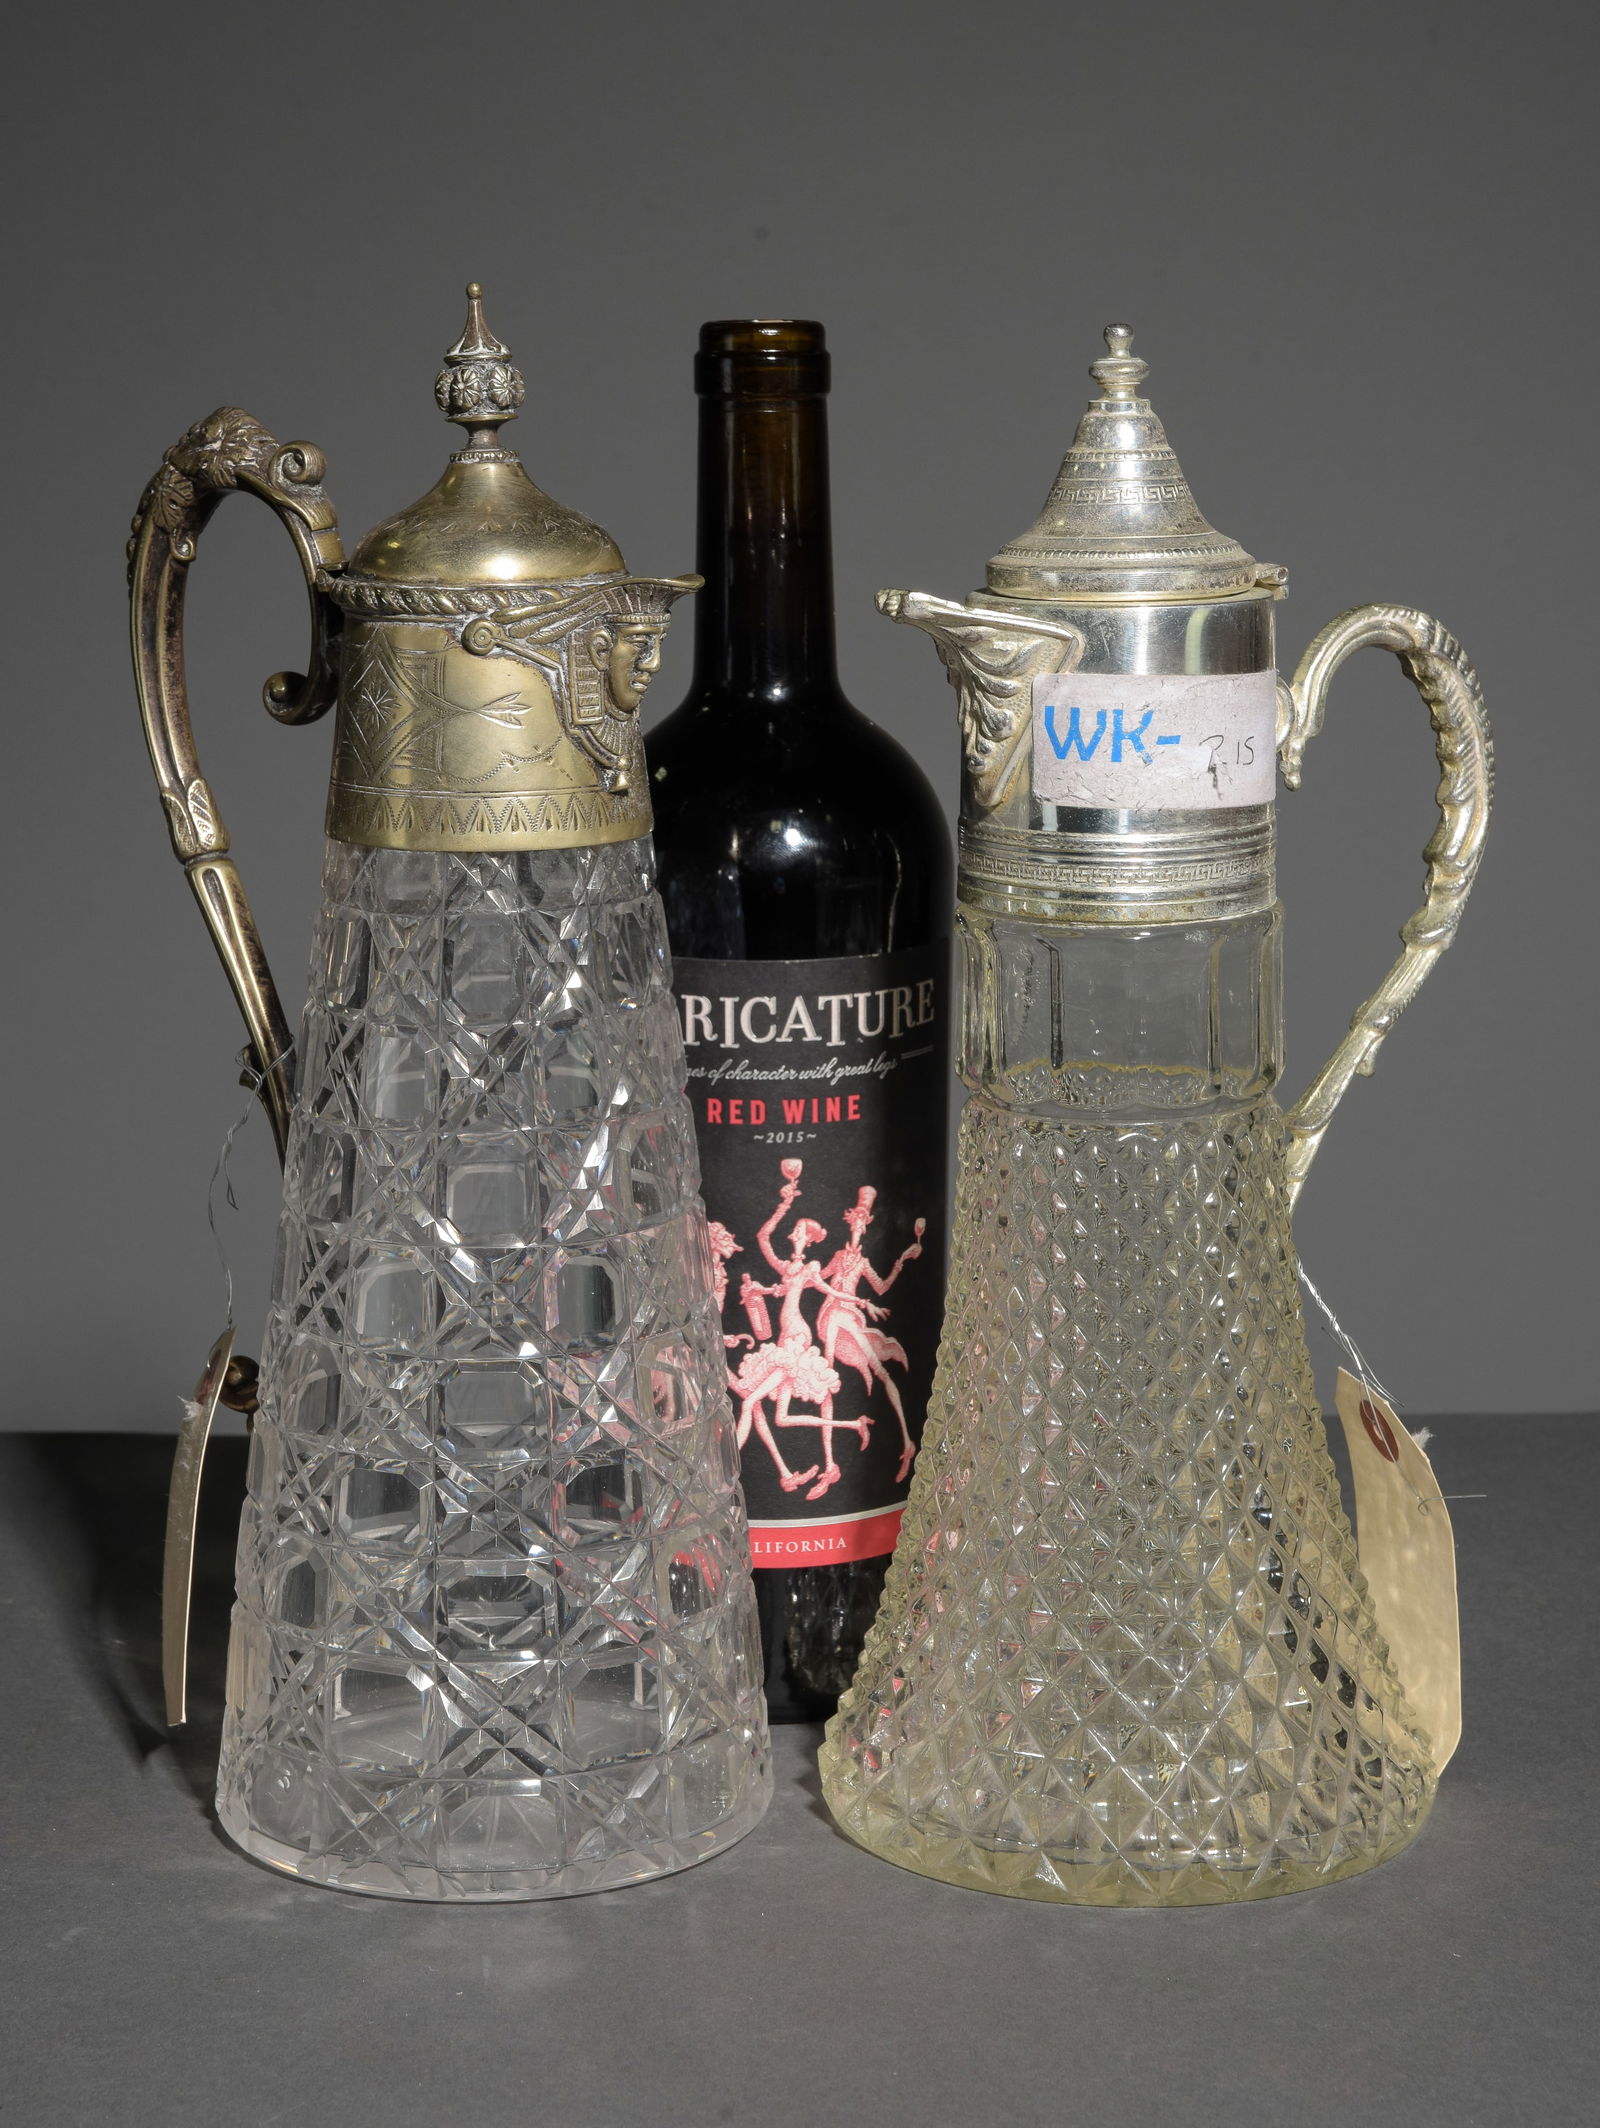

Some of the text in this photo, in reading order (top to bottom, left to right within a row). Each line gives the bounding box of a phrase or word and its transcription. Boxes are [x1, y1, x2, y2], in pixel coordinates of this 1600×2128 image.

[681, 979, 935, 1048] RICATURE
[707, 1058, 734, 1086] of
[724, 1059, 798, 1081] character
[799, 1057, 838, 1080] with
[830, 1058, 874, 1086] great
[872, 1050, 898, 1079] legs
[707, 1094, 862, 1125] RED WINE
[751, 1537, 848, 1554] LIFORNIA
